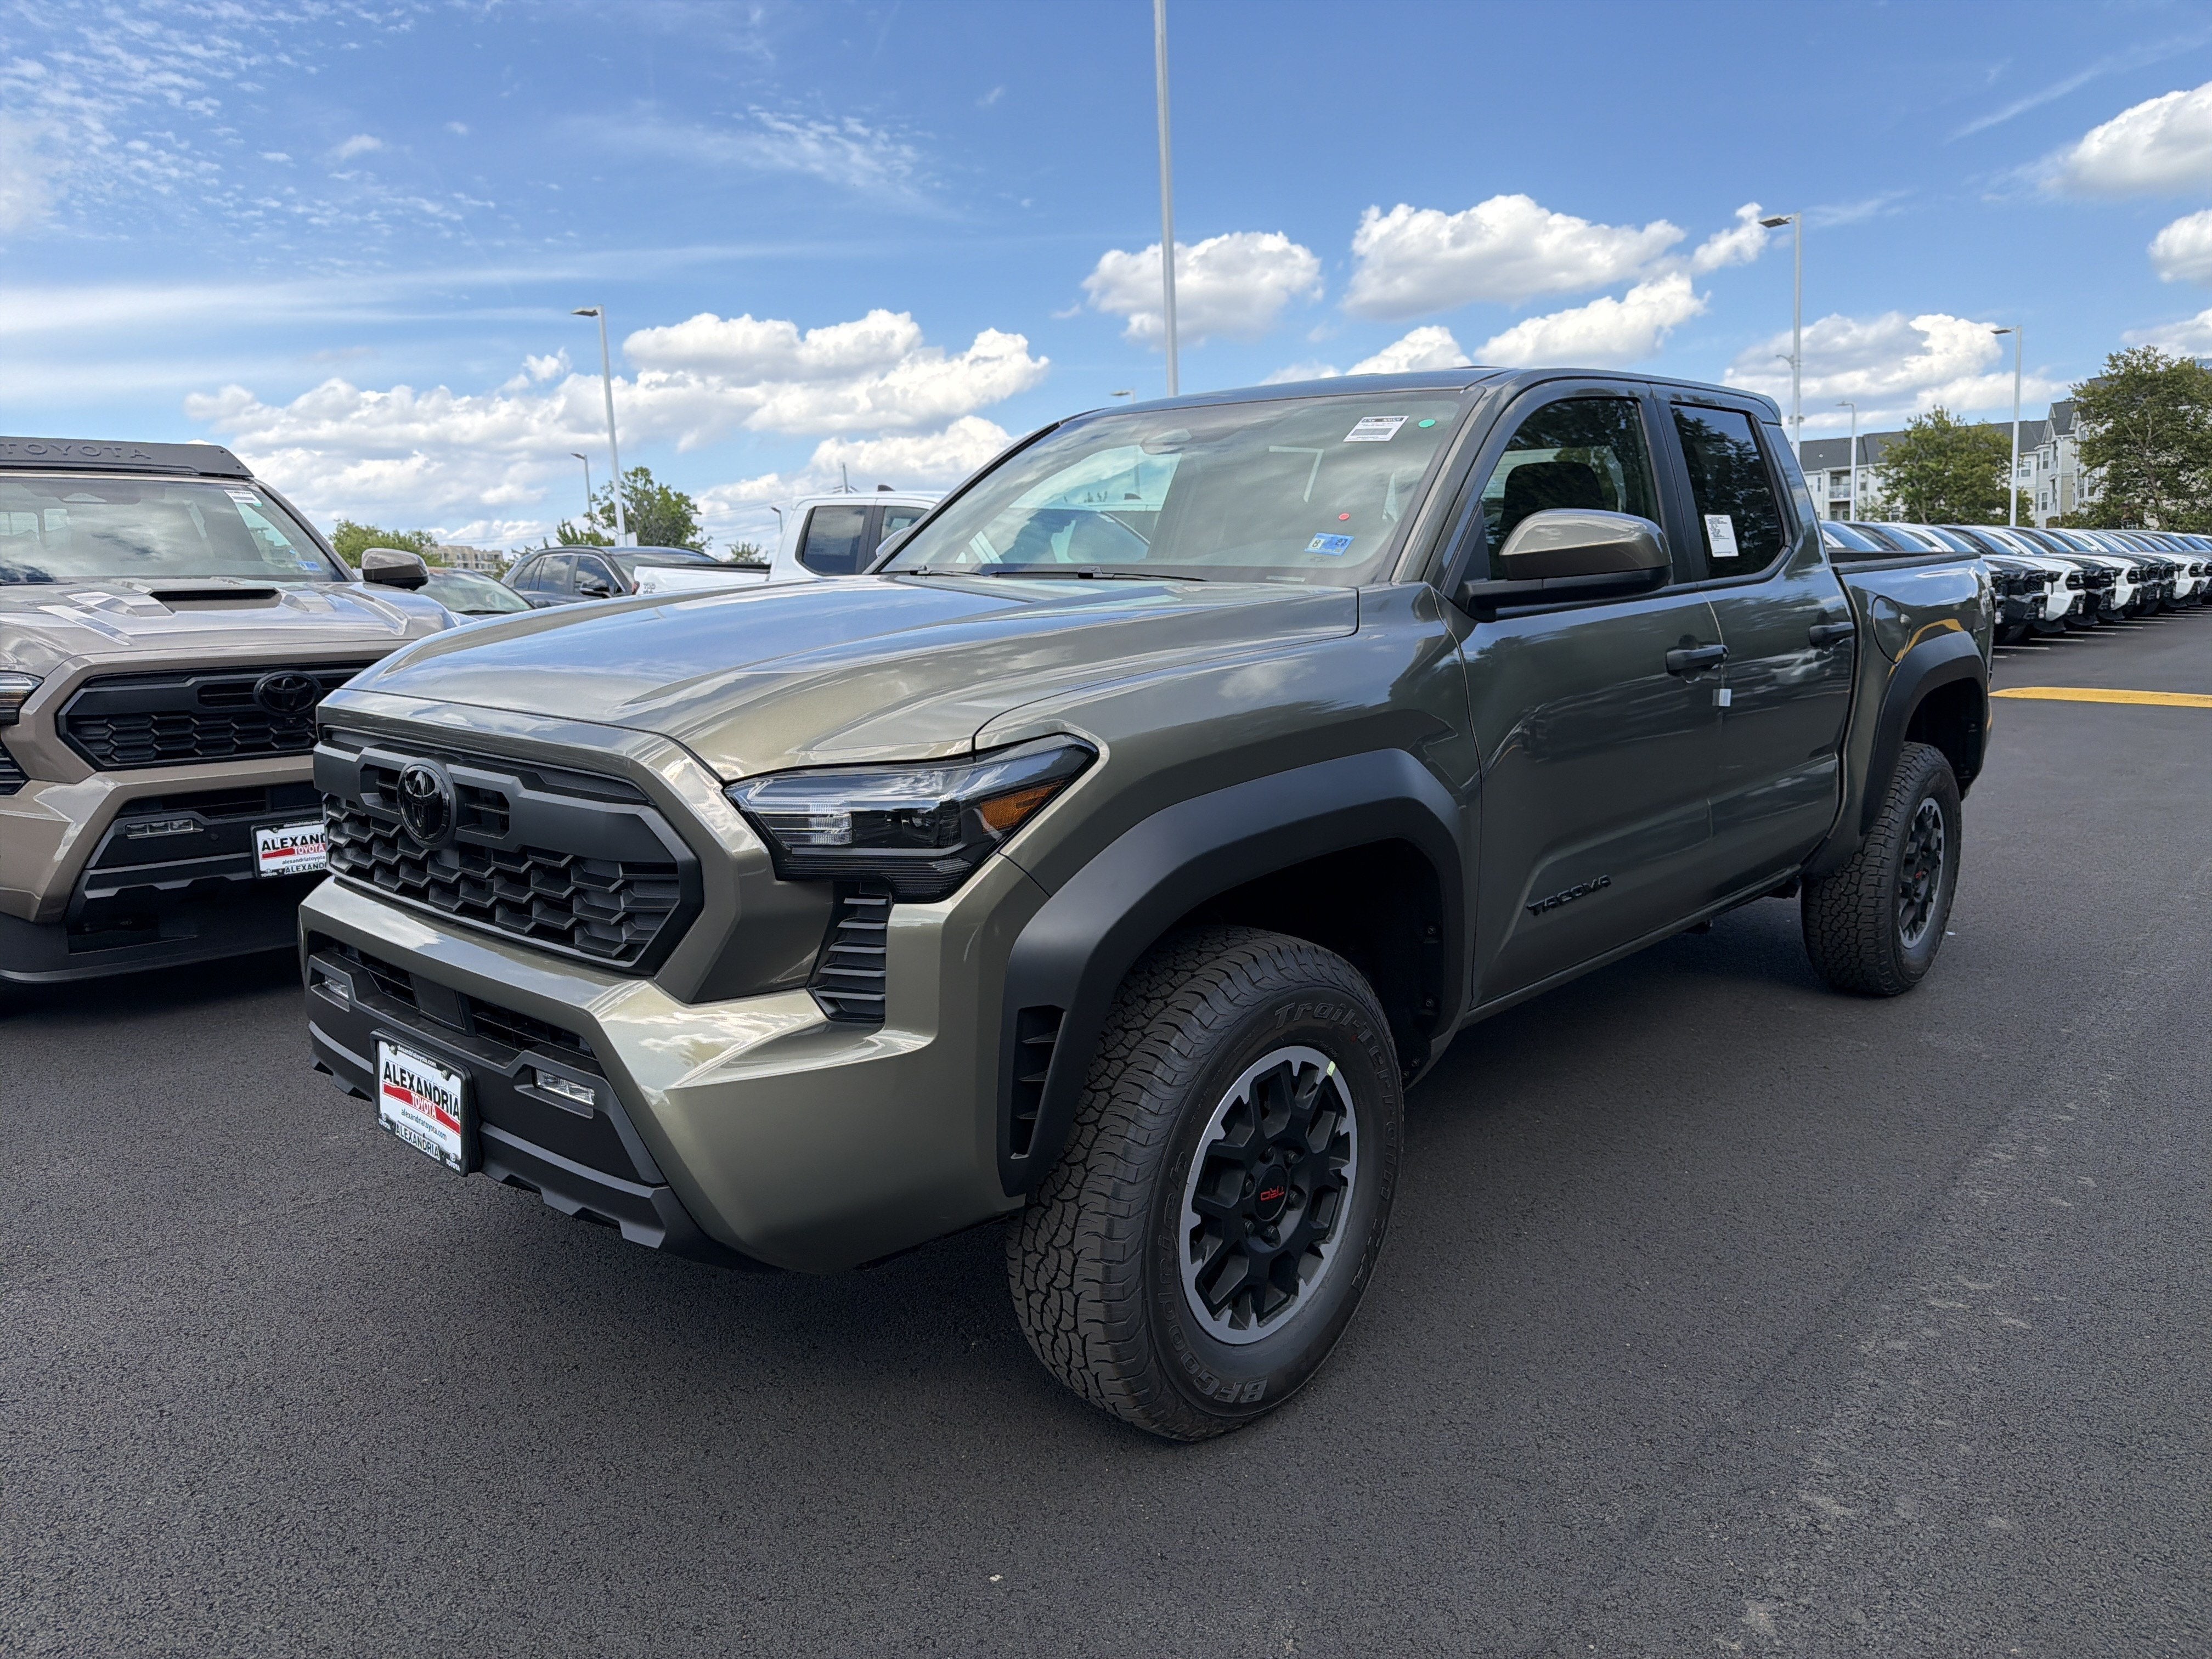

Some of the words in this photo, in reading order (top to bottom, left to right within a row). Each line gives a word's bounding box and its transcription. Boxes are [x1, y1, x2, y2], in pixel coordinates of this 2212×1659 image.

[0, 442, 152, 460] TOYOTA
[294, 844, 325, 855] TOYOTA
[1527, 874, 1612, 916] TACOMA
[383, 1060, 460, 1120] ALEXANDRIA
[410, 1091, 437, 1119] TOYOTA
[401, 1108, 447, 1142] alexandriatoyota.com
[395, 1123, 441, 1160] ALEXANDRIA
[445, 1158, 461, 1172] TOYOTA
[1260, 1185, 1285, 1201] TRD
